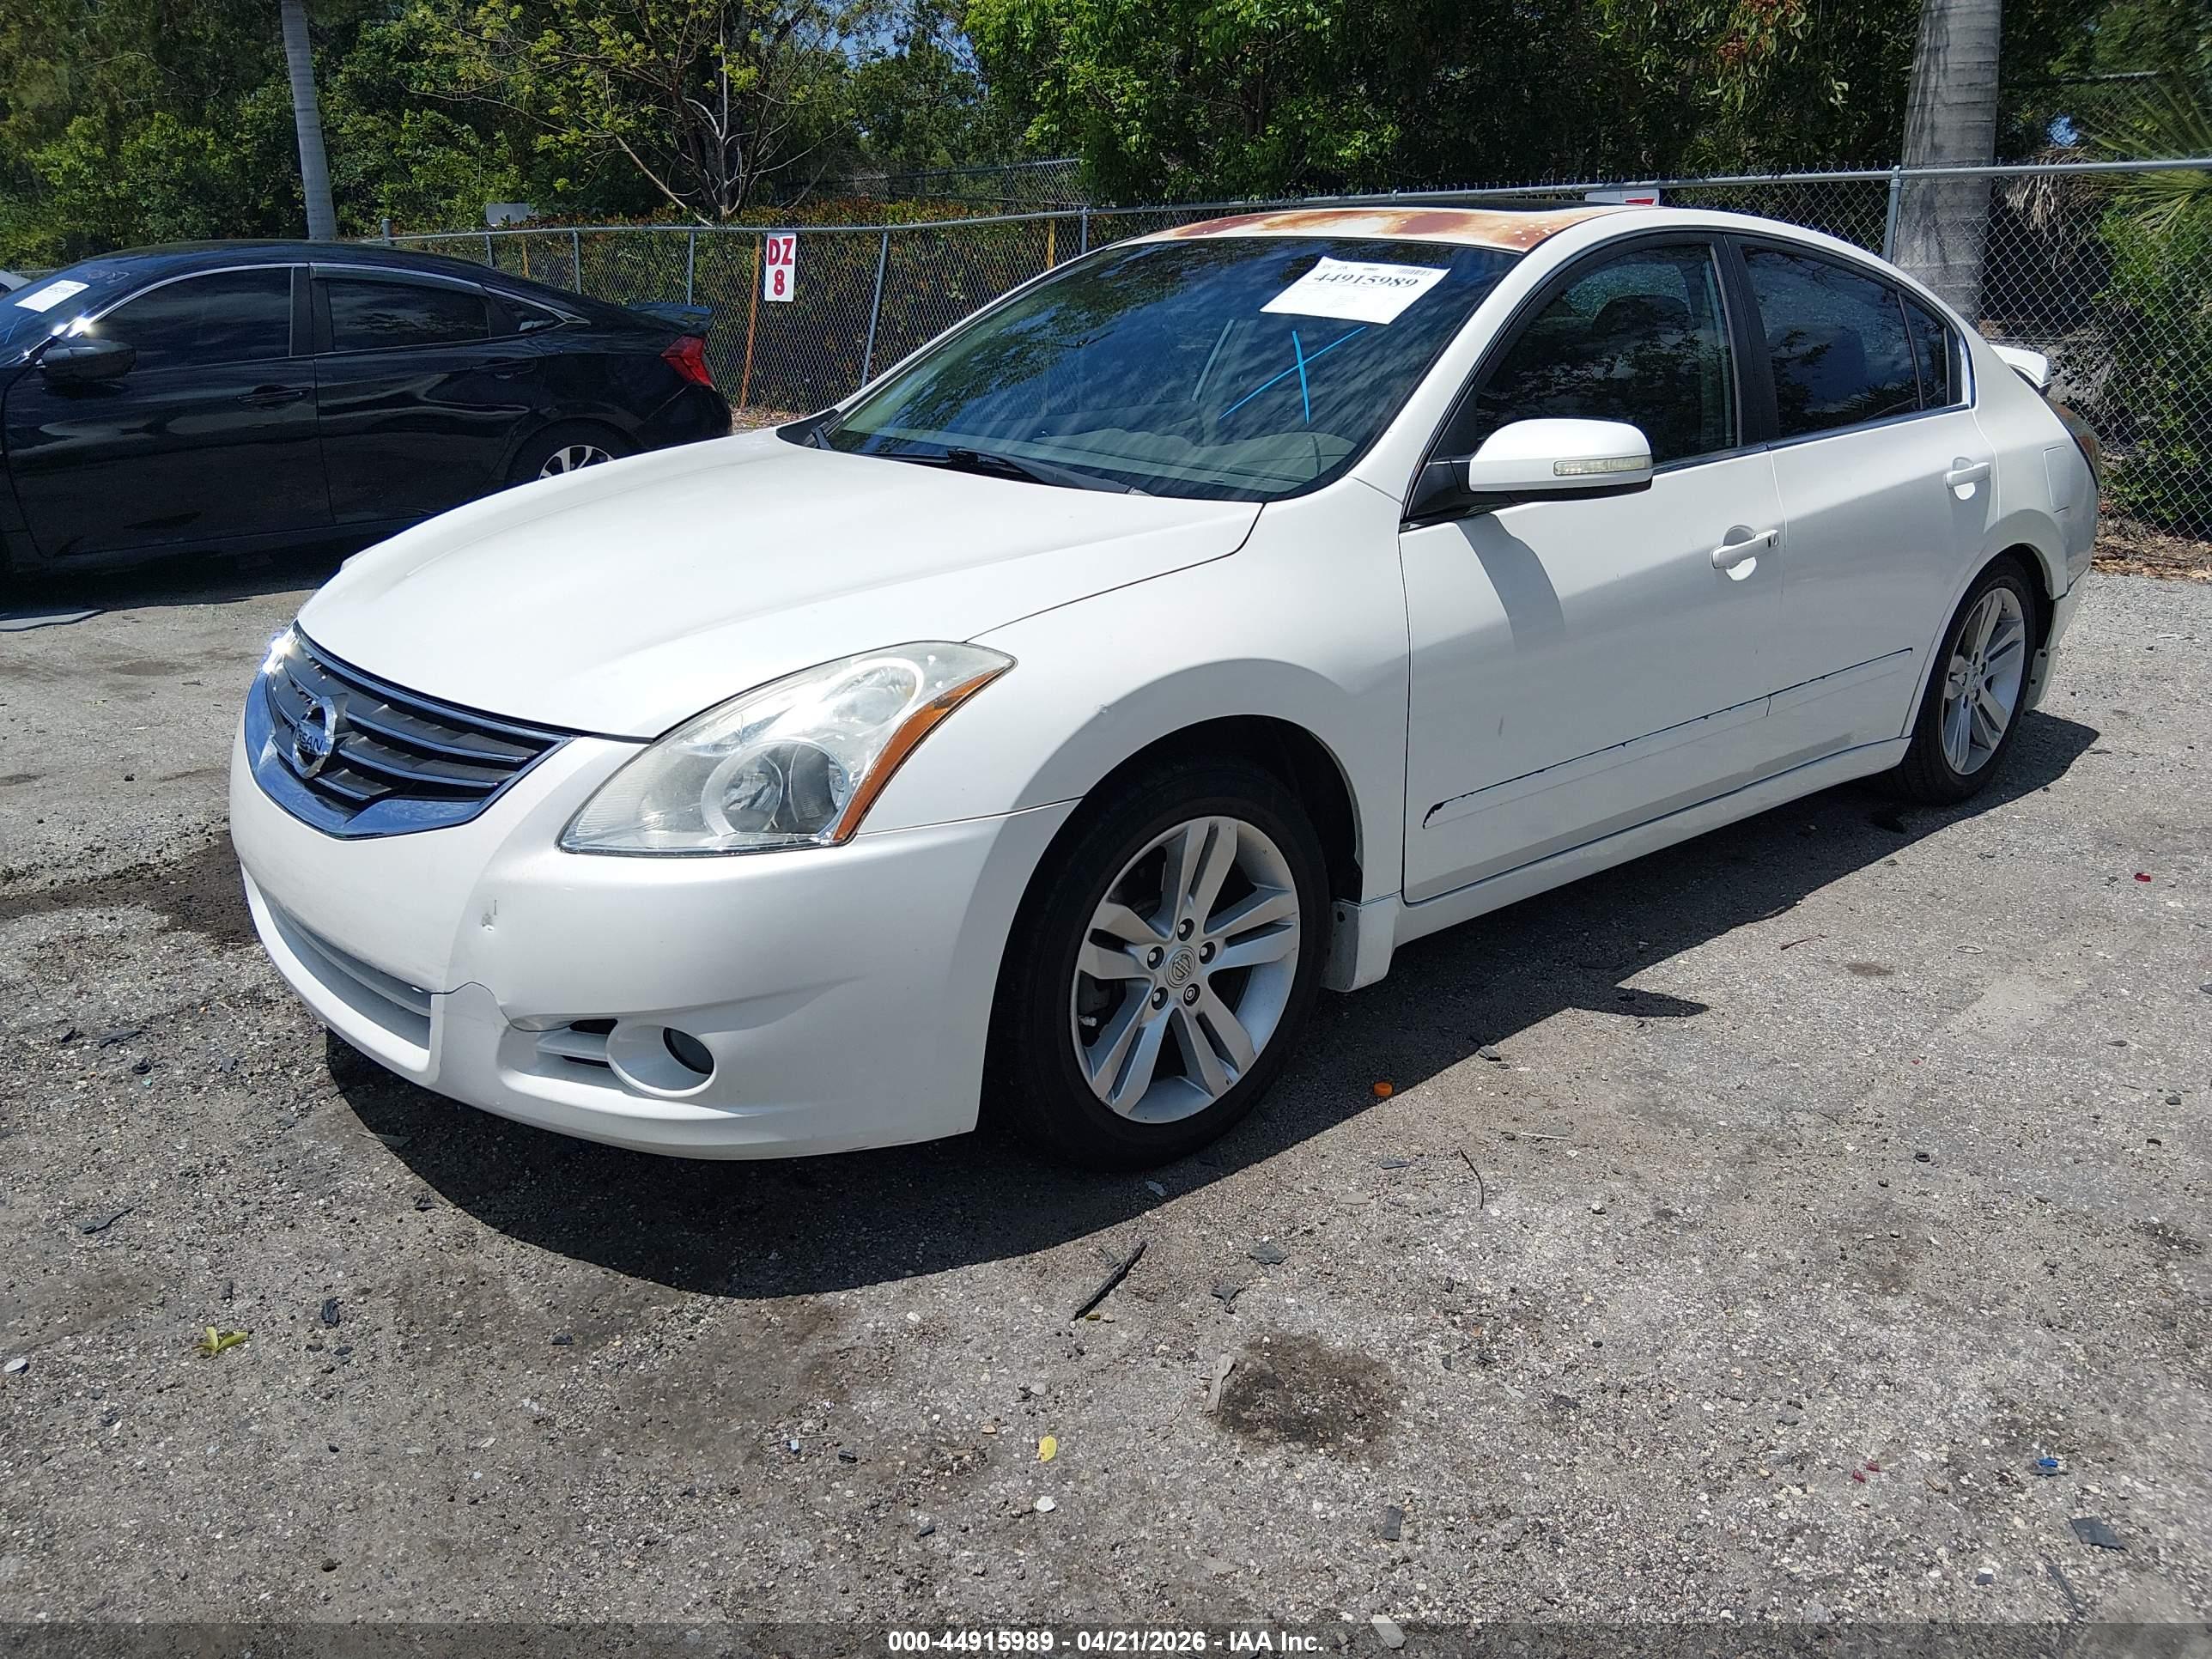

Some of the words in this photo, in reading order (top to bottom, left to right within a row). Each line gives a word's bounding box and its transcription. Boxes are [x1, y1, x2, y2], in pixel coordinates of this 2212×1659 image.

[769, 238, 793, 265] DZ
[774, 269, 785, 296] 8
[1314, 273, 1419, 288] 44915989
